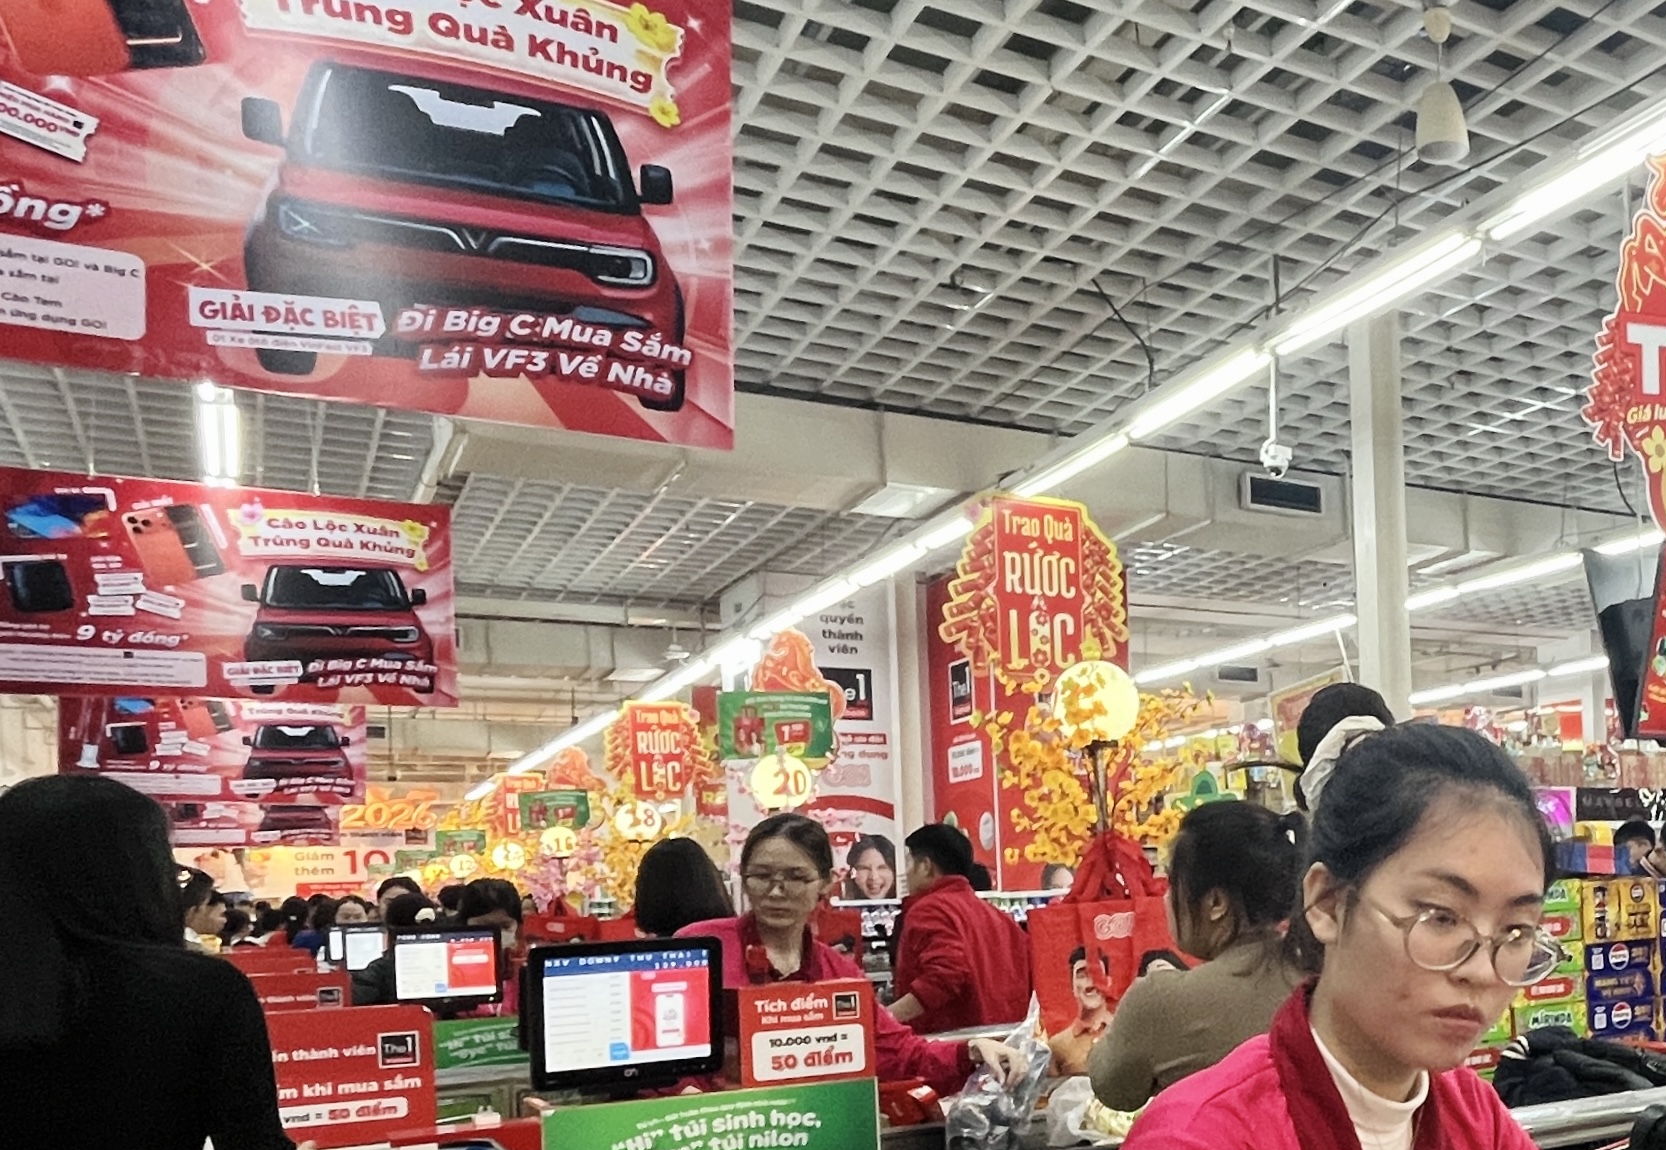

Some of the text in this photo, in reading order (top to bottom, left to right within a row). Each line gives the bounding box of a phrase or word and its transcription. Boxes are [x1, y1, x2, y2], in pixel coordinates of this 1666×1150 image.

[428, 11, 515, 53] Quà
[528, 34, 654, 95] Khủng
[198, 294, 379, 335] GIẢI ĐẶC BIỆT
[398, 305, 694, 367] Đi Big C Mua Sắm
[419, 345, 675, 397] Lái VF3 Về Nhà
[1626, 403, 1653, 426] Giá
[353, 521, 401, 539] Xuân
[1003, 509, 1074, 544] Trao Quà
[1002, 541, 1077, 599] RƯỚC
[76, 623, 97, 642] 9
[772, 768, 807, 796] 20
[339, 802, 437, 831] 2026
[753, 991, 829, 1014] Tích điểm
[769, 1032, 838, 1049] 10.000 vnd
[771, 1044, 854, 1072] 50 điểm
[302, 1073, 422, 1098] khi mua sắm
[668, 1117, 709, 1142] túi
[711, 1109, 767, 1135] sinh
[769, 1108, 822, 1131] học,
[747, 1130, 810, 1150] nilon
